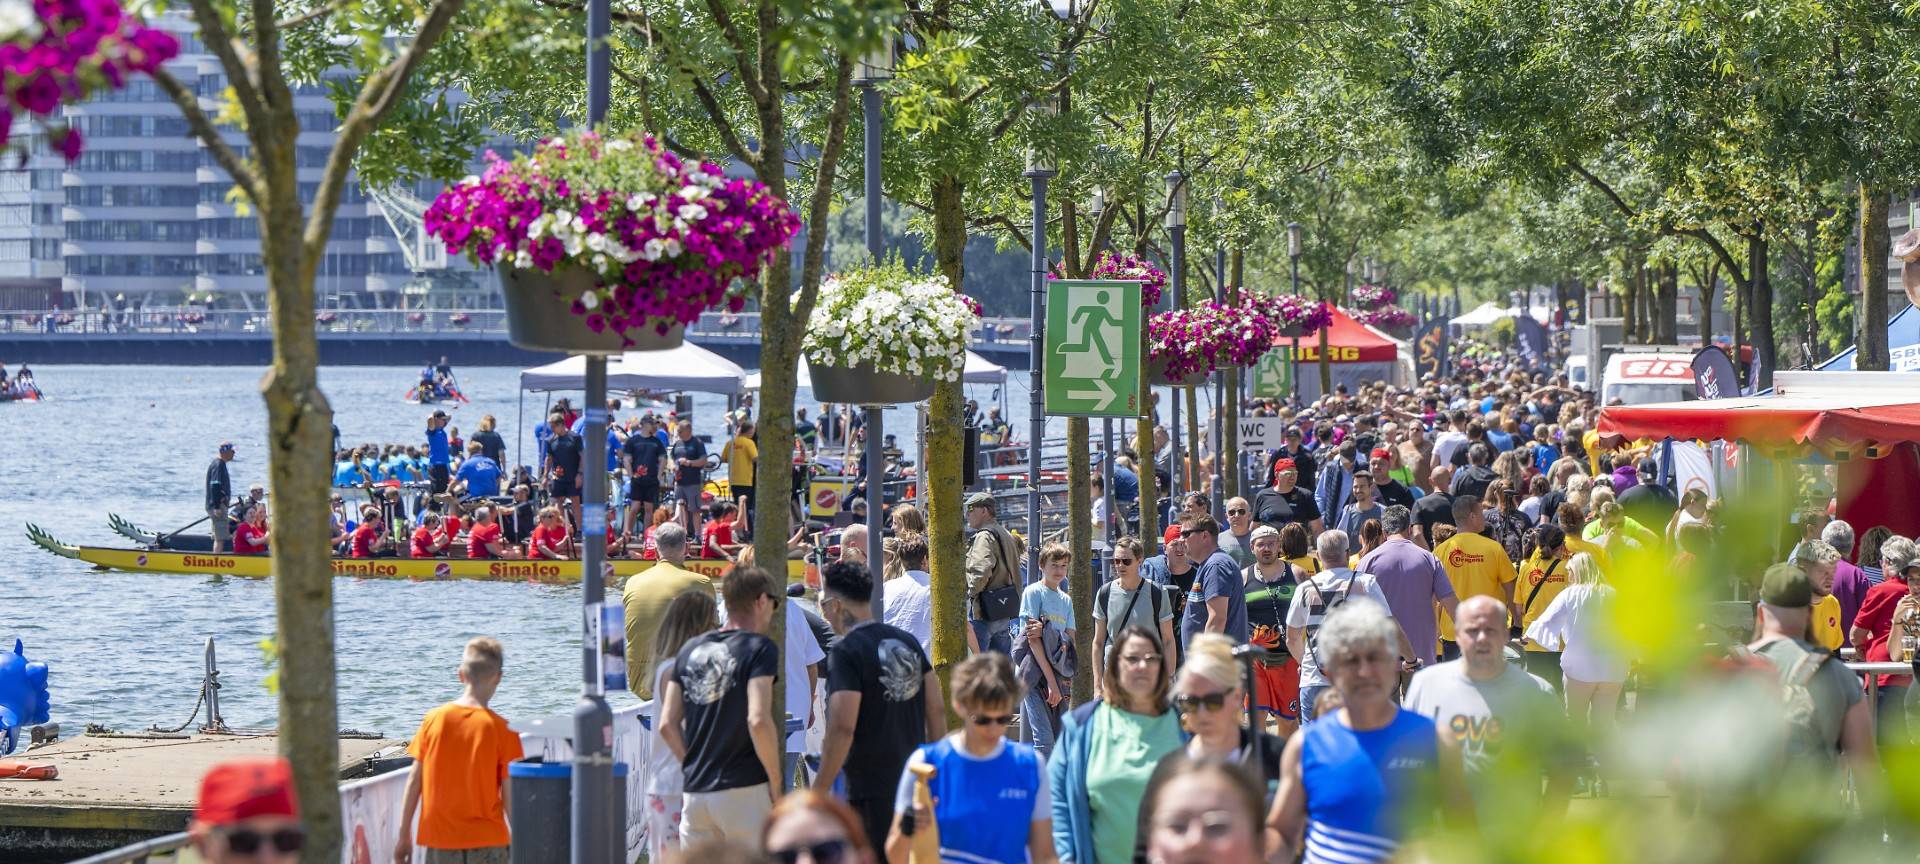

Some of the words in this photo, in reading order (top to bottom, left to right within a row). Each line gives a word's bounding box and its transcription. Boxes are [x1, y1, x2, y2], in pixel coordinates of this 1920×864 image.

[1626, 361, 1687, 376] EIS
[1240, 423, 1265, 438] WC
[183, 555, 236, 569] Sinalco
[488, 562, 561, 577] Sinalco
